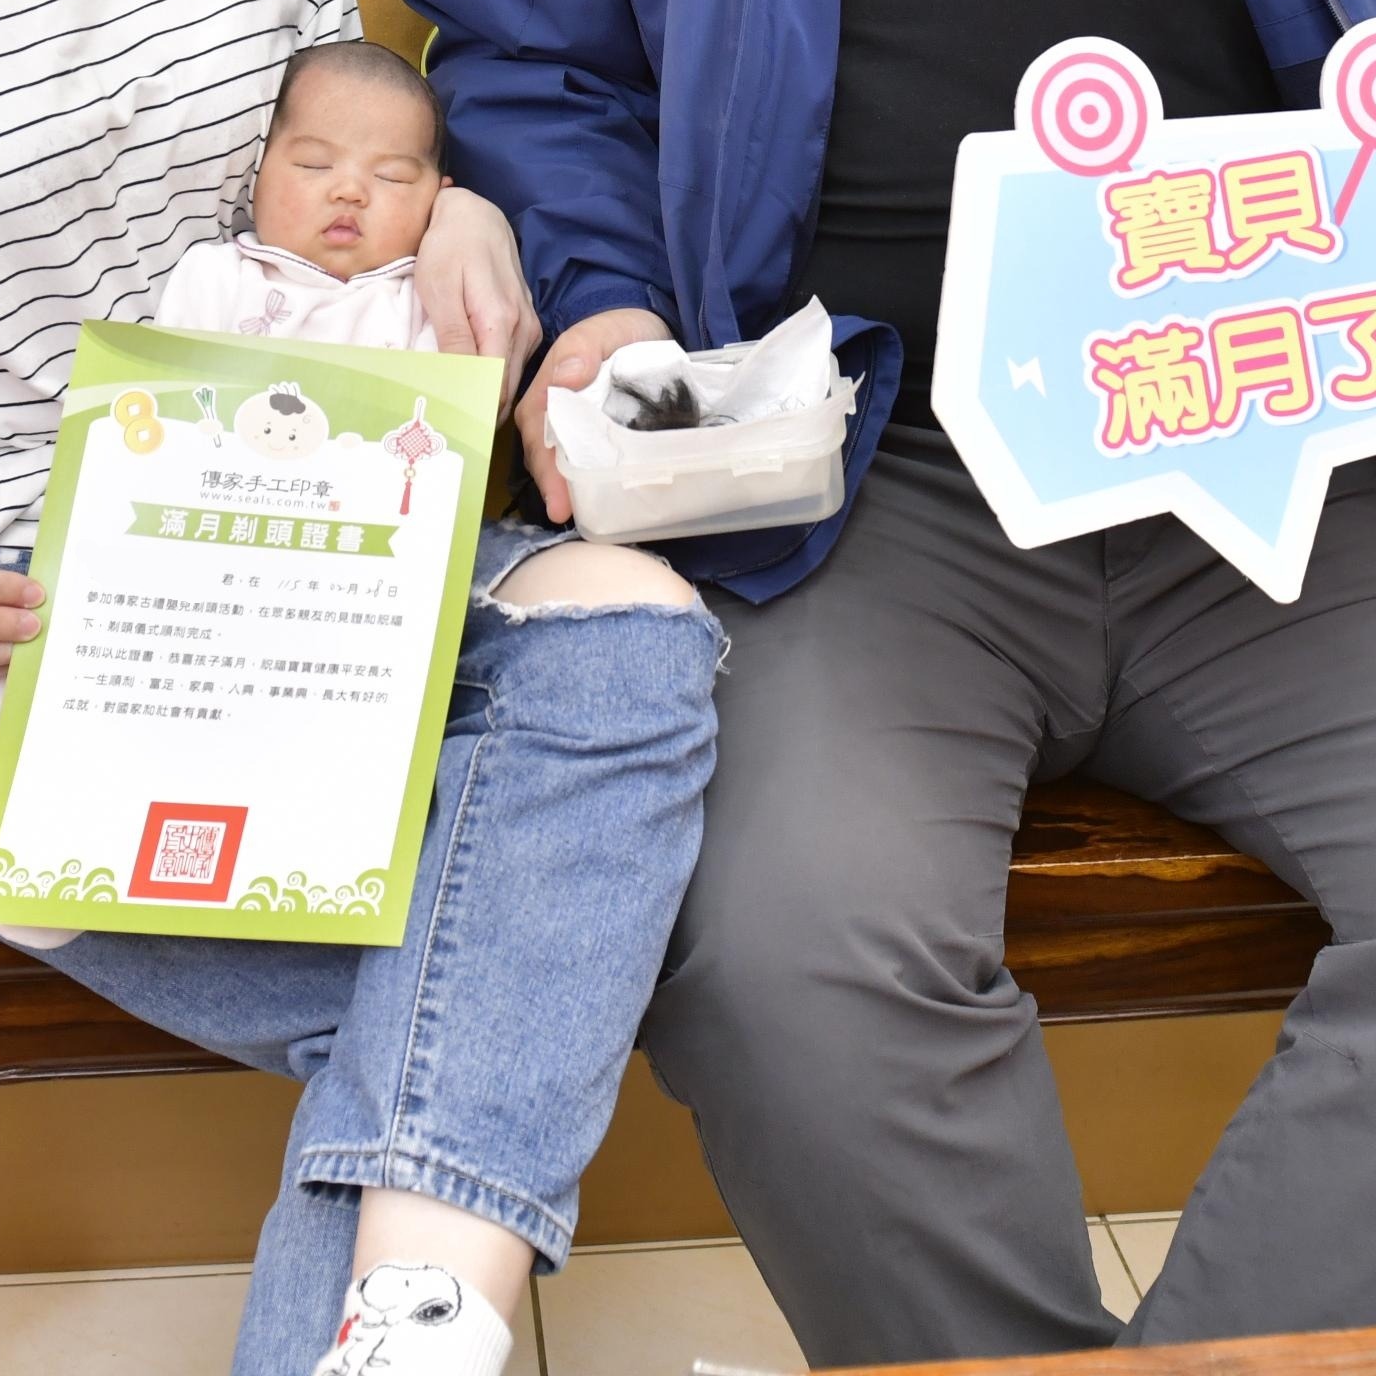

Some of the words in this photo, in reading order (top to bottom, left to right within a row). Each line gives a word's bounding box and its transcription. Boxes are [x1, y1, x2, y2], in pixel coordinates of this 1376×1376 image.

[1104, 150, 1337, 291] 寶貝
[199, 491, 327, 510] www.seals.com.tw
[200, 469, 334, 498] 傳家手工印章
[158, 508, 364, 553] 滿月剃頭證書
